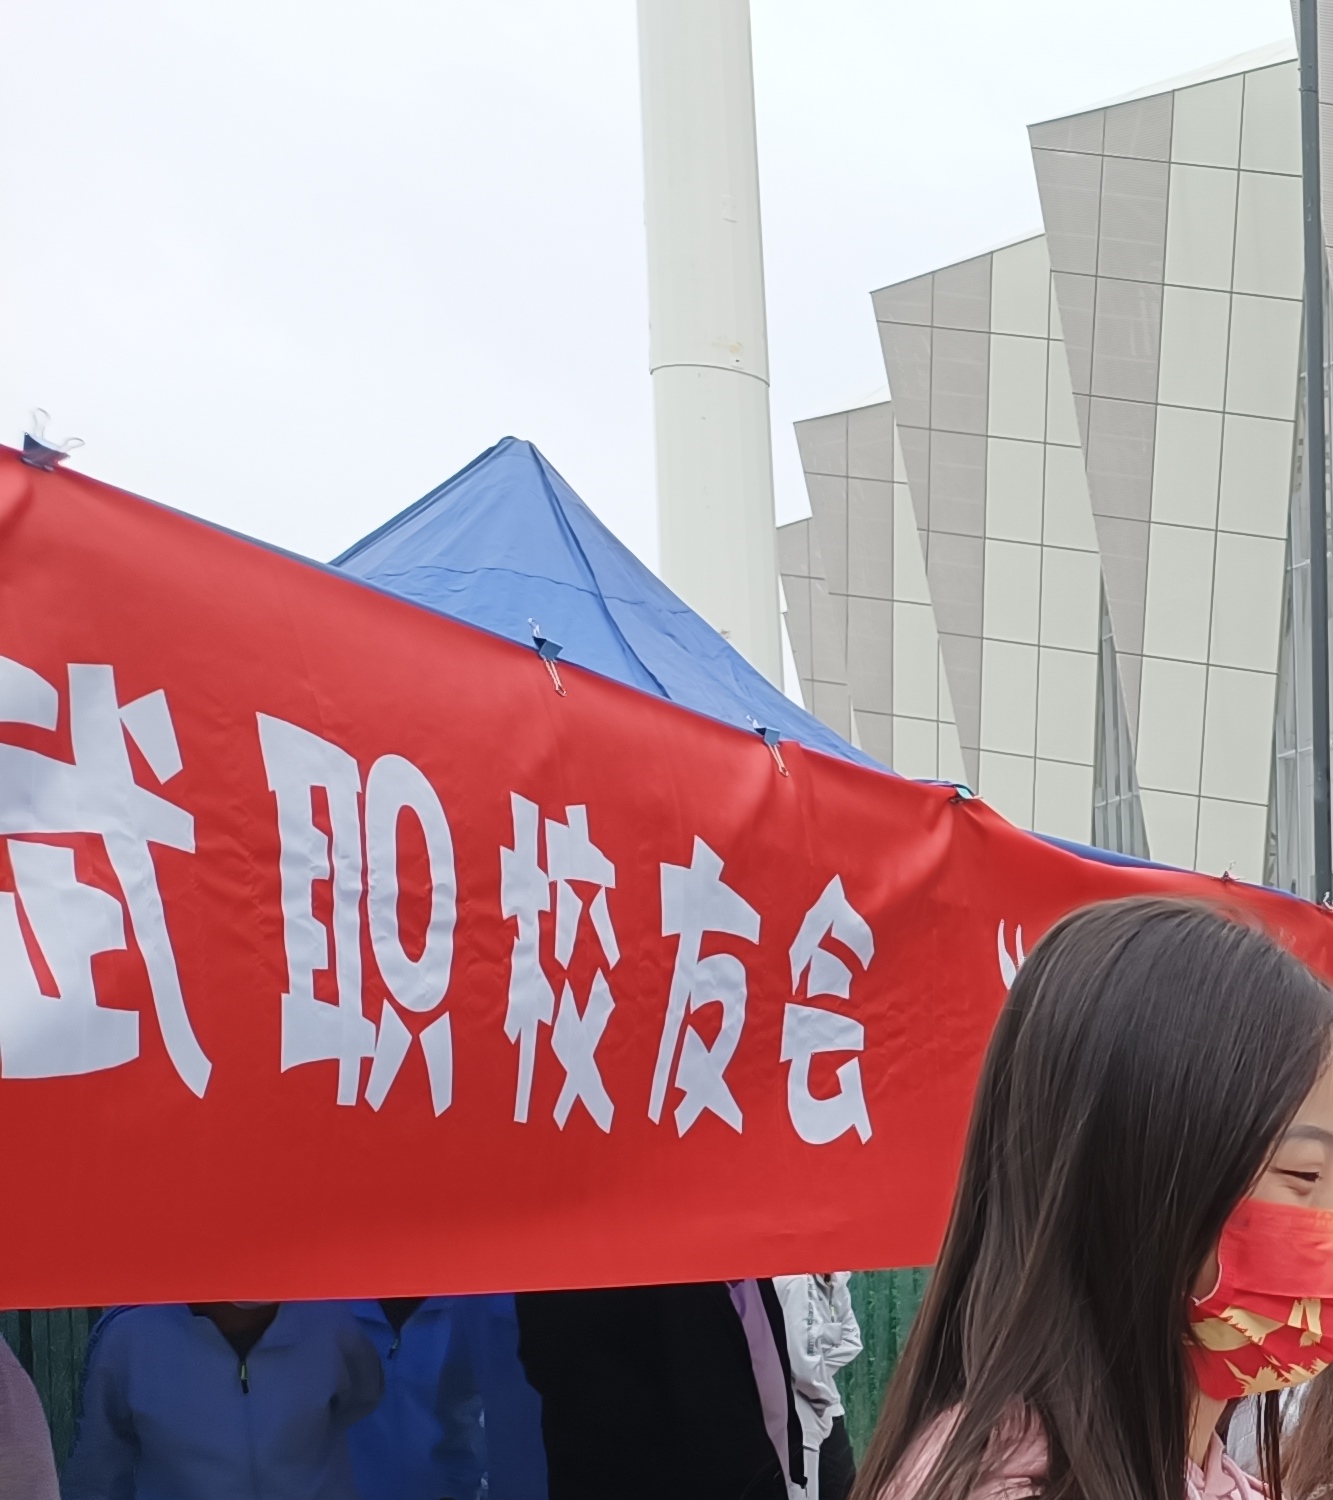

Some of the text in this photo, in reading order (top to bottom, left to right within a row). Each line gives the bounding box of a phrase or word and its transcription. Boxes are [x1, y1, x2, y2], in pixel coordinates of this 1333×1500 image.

[0, 655, 875, 1145] 武职校友会
